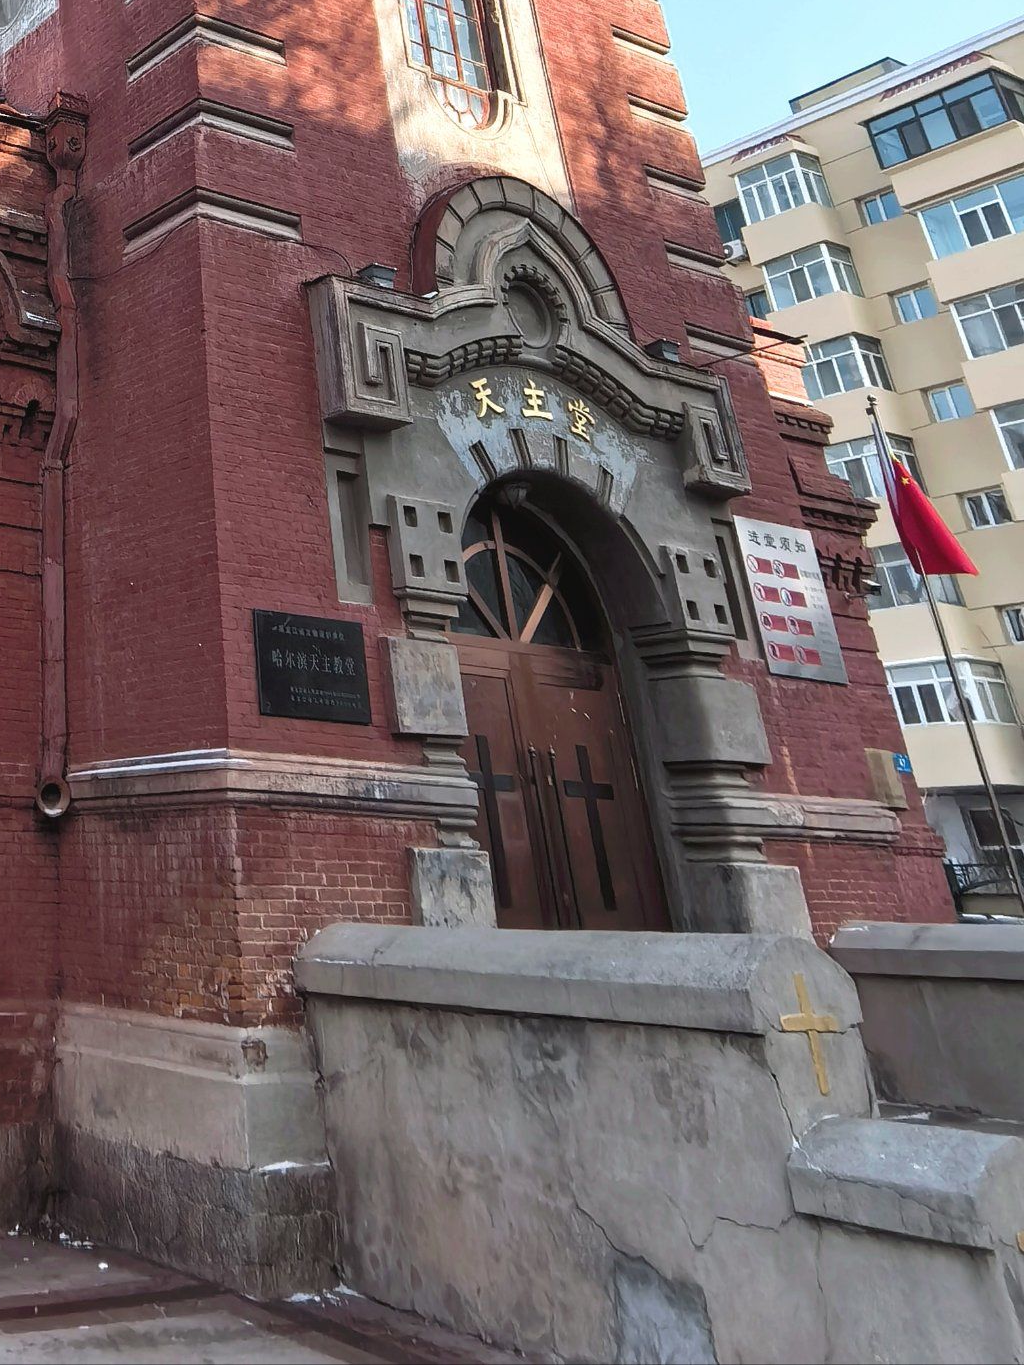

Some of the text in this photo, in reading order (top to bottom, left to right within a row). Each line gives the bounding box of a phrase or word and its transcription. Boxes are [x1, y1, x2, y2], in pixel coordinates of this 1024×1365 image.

[469, 377, 596, 442] 天主堂
[747, 530, 807, 553] 进堂须知
[271, 647, 357, 676] 哈尔滨天主教堂
